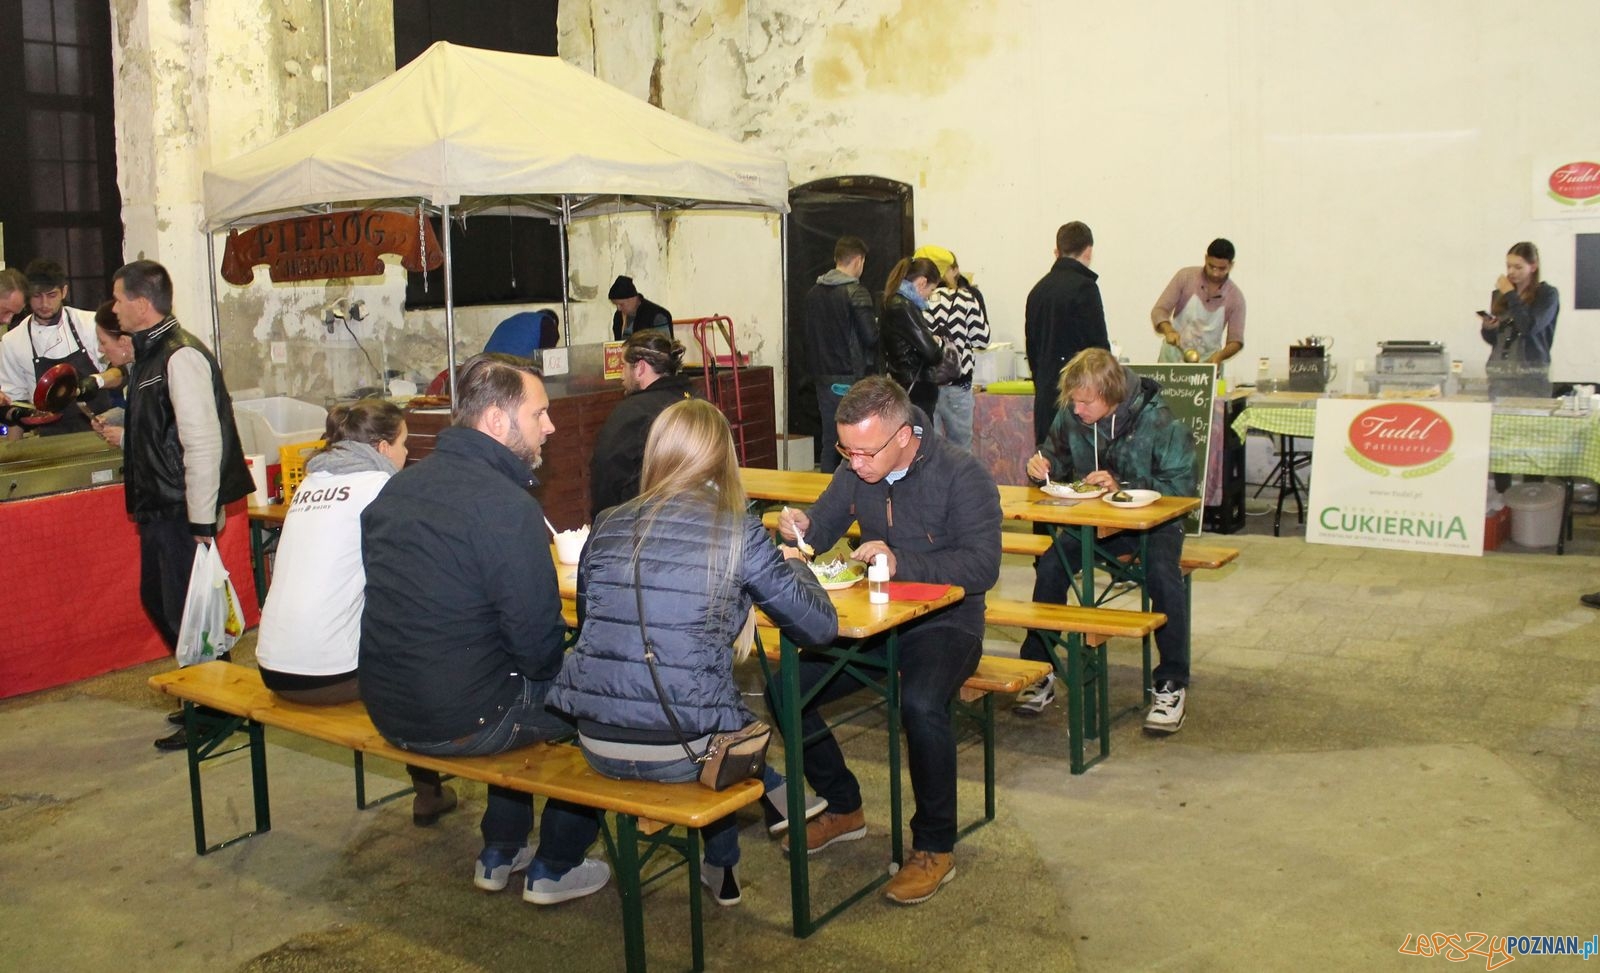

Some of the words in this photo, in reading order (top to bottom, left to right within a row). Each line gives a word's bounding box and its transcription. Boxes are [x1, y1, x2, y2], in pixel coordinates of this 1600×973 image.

[1360, 416, 1440, 441] Tudel
[1363, 441, 1432, 454] Patisserie
[292, 486, 351, 506] ARGUS
[1319, 506, 1468, 541] CUKIERNIA
